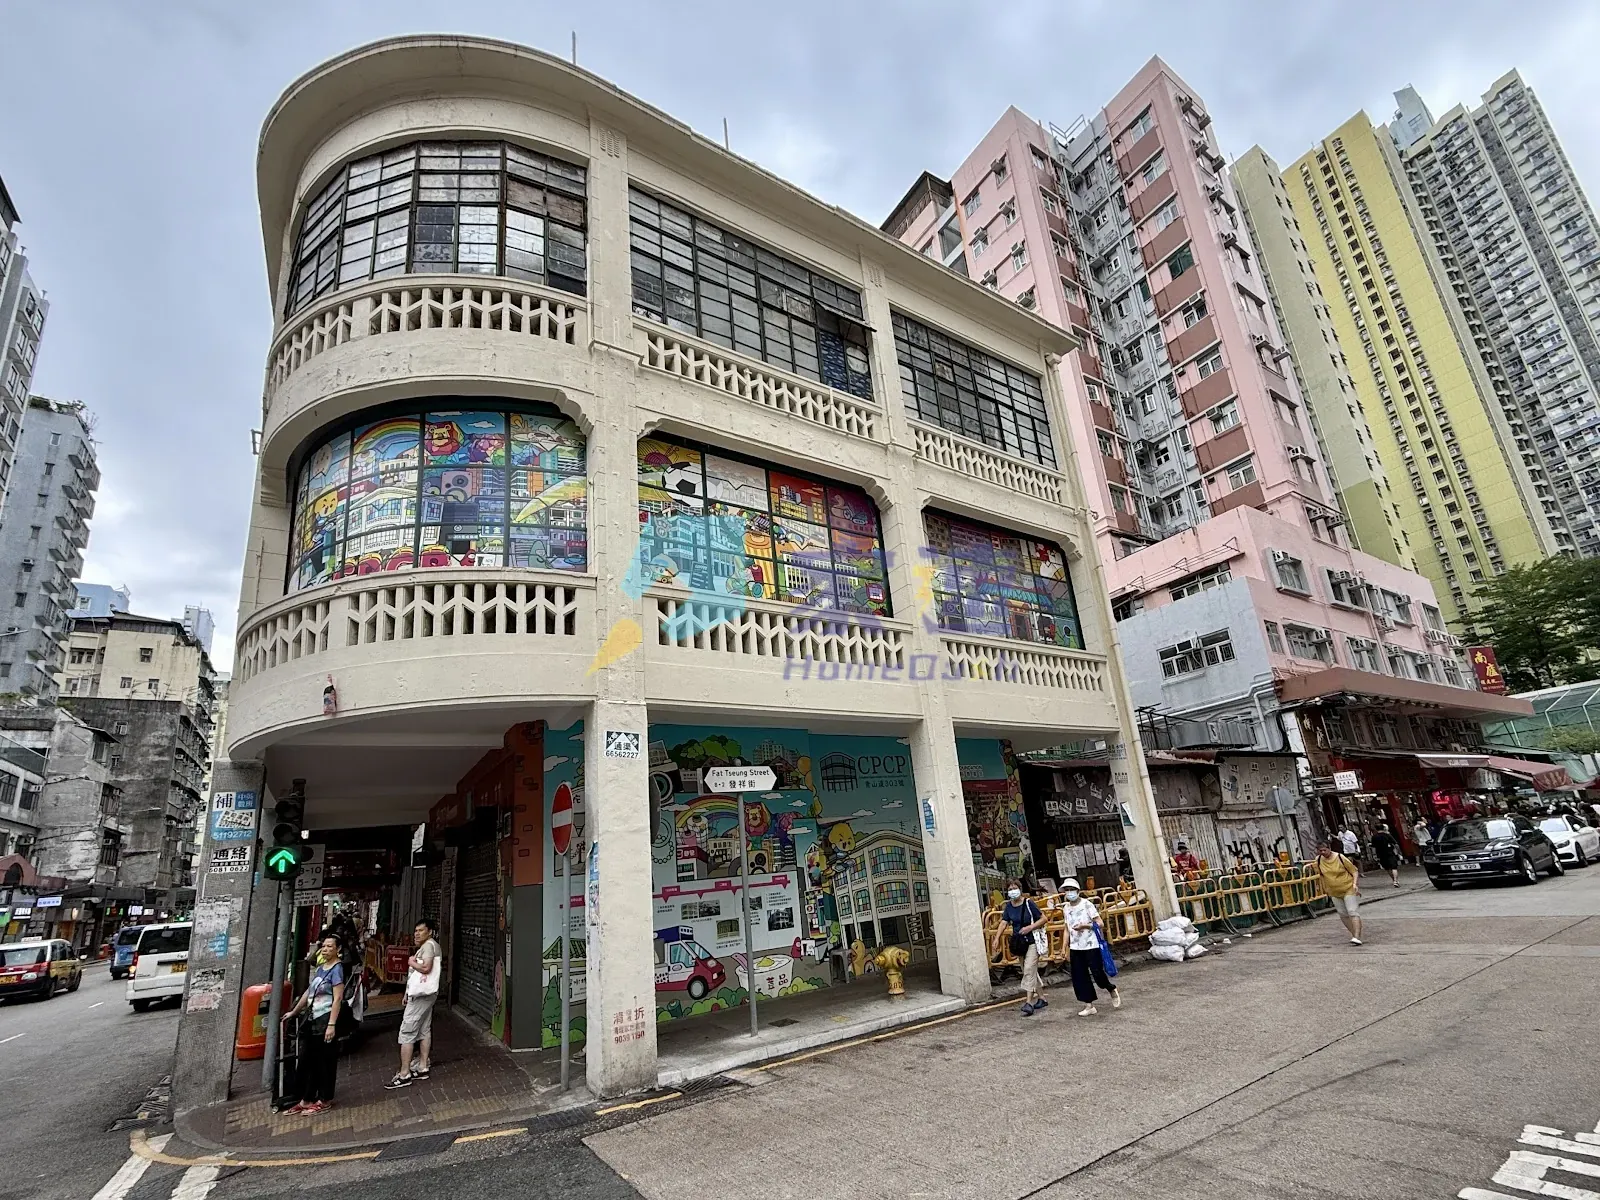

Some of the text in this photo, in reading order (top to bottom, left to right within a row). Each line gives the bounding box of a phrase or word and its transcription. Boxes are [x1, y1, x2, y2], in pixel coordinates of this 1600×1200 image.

[606, 750, 638, 759] 66562227
[858, 755, 906, 775] CPCP
[711, 768, 770, 778] Fat Tseung Street
[729, 779, 756, 789] 發祥街
[216, 793, 233, 809] 補
[213, 830, 253, 840] 51192712
[213, 846, 248, 860] 通絡
